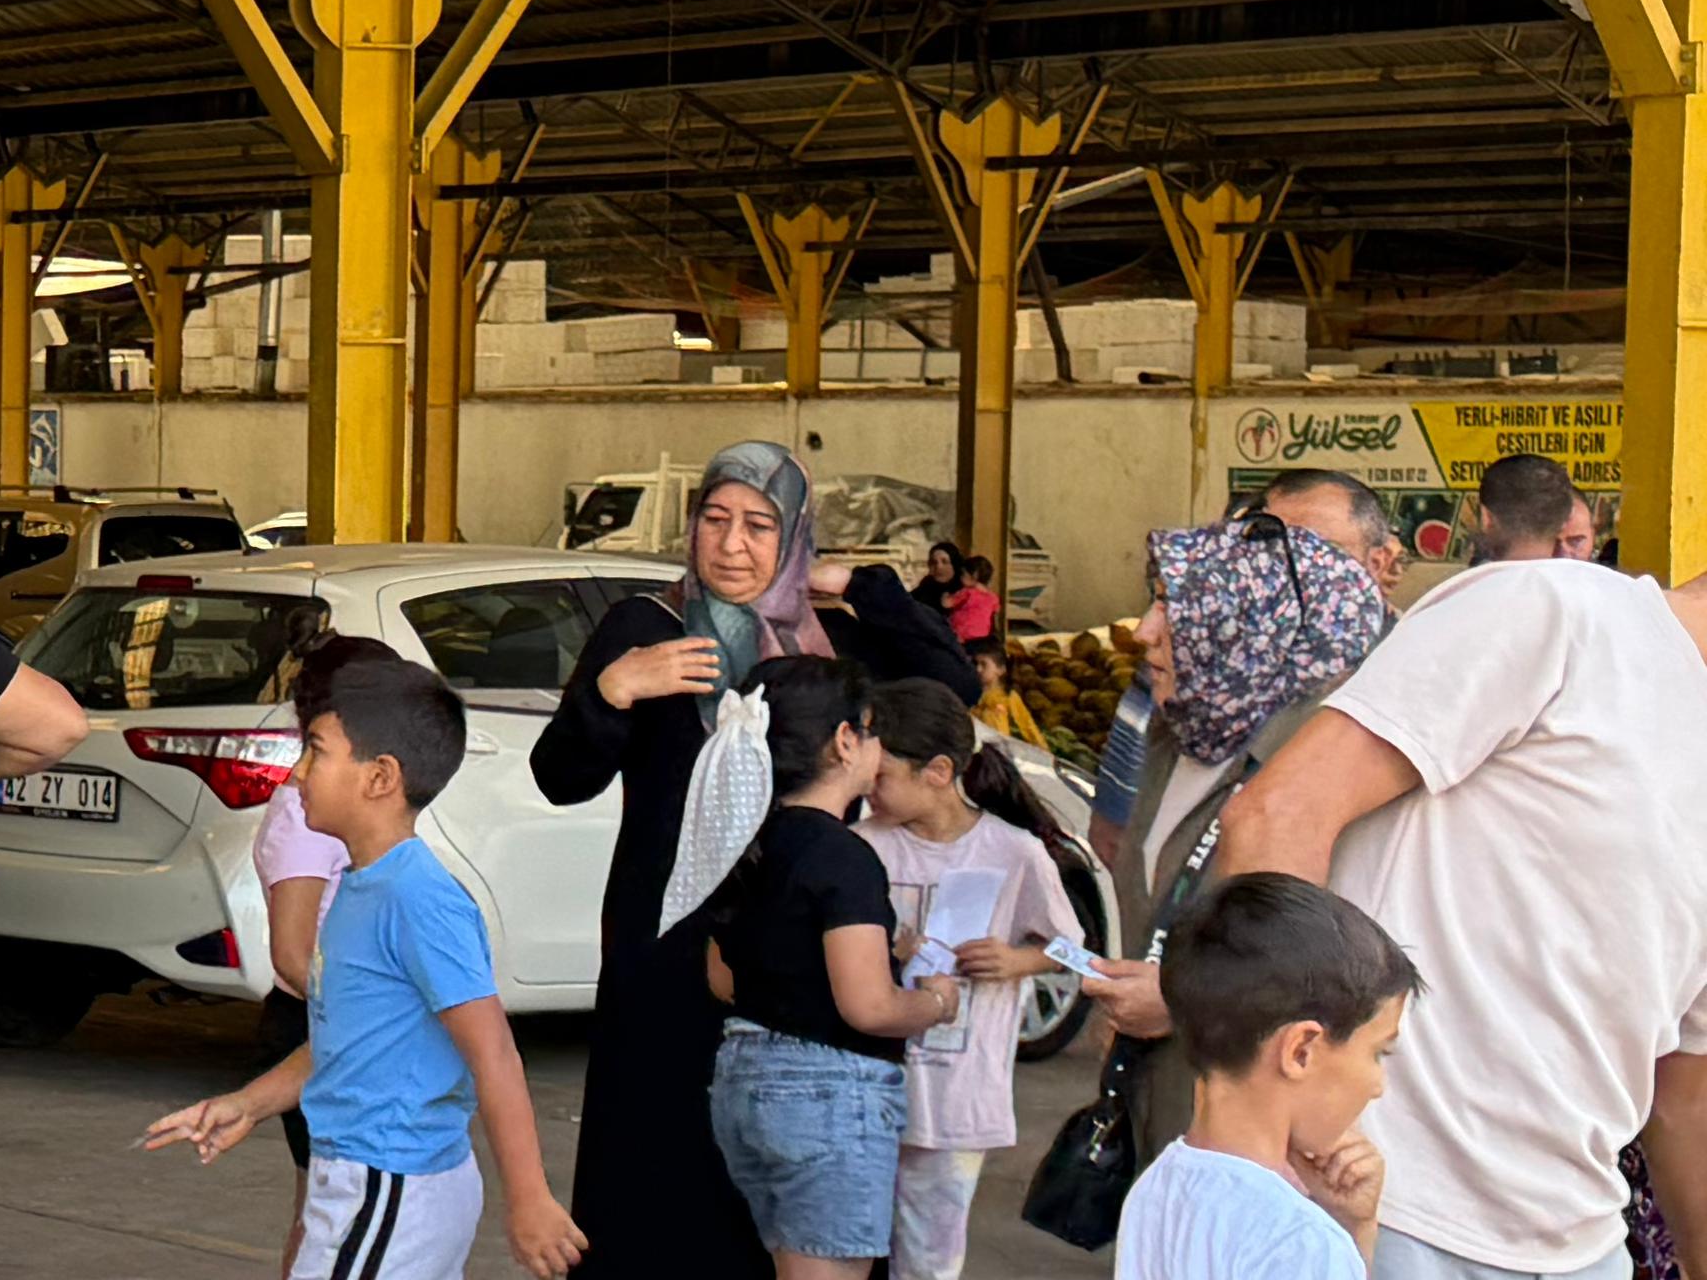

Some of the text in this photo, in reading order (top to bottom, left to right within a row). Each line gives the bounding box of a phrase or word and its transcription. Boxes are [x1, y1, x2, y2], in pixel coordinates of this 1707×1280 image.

[1552, 406, 1570, 427] VE
[1282, 412, 1401, 460] Yüksel
[1573, 460, 1621, 483] ADRES
[4, 775, 112, 808] 42 ZY 014
